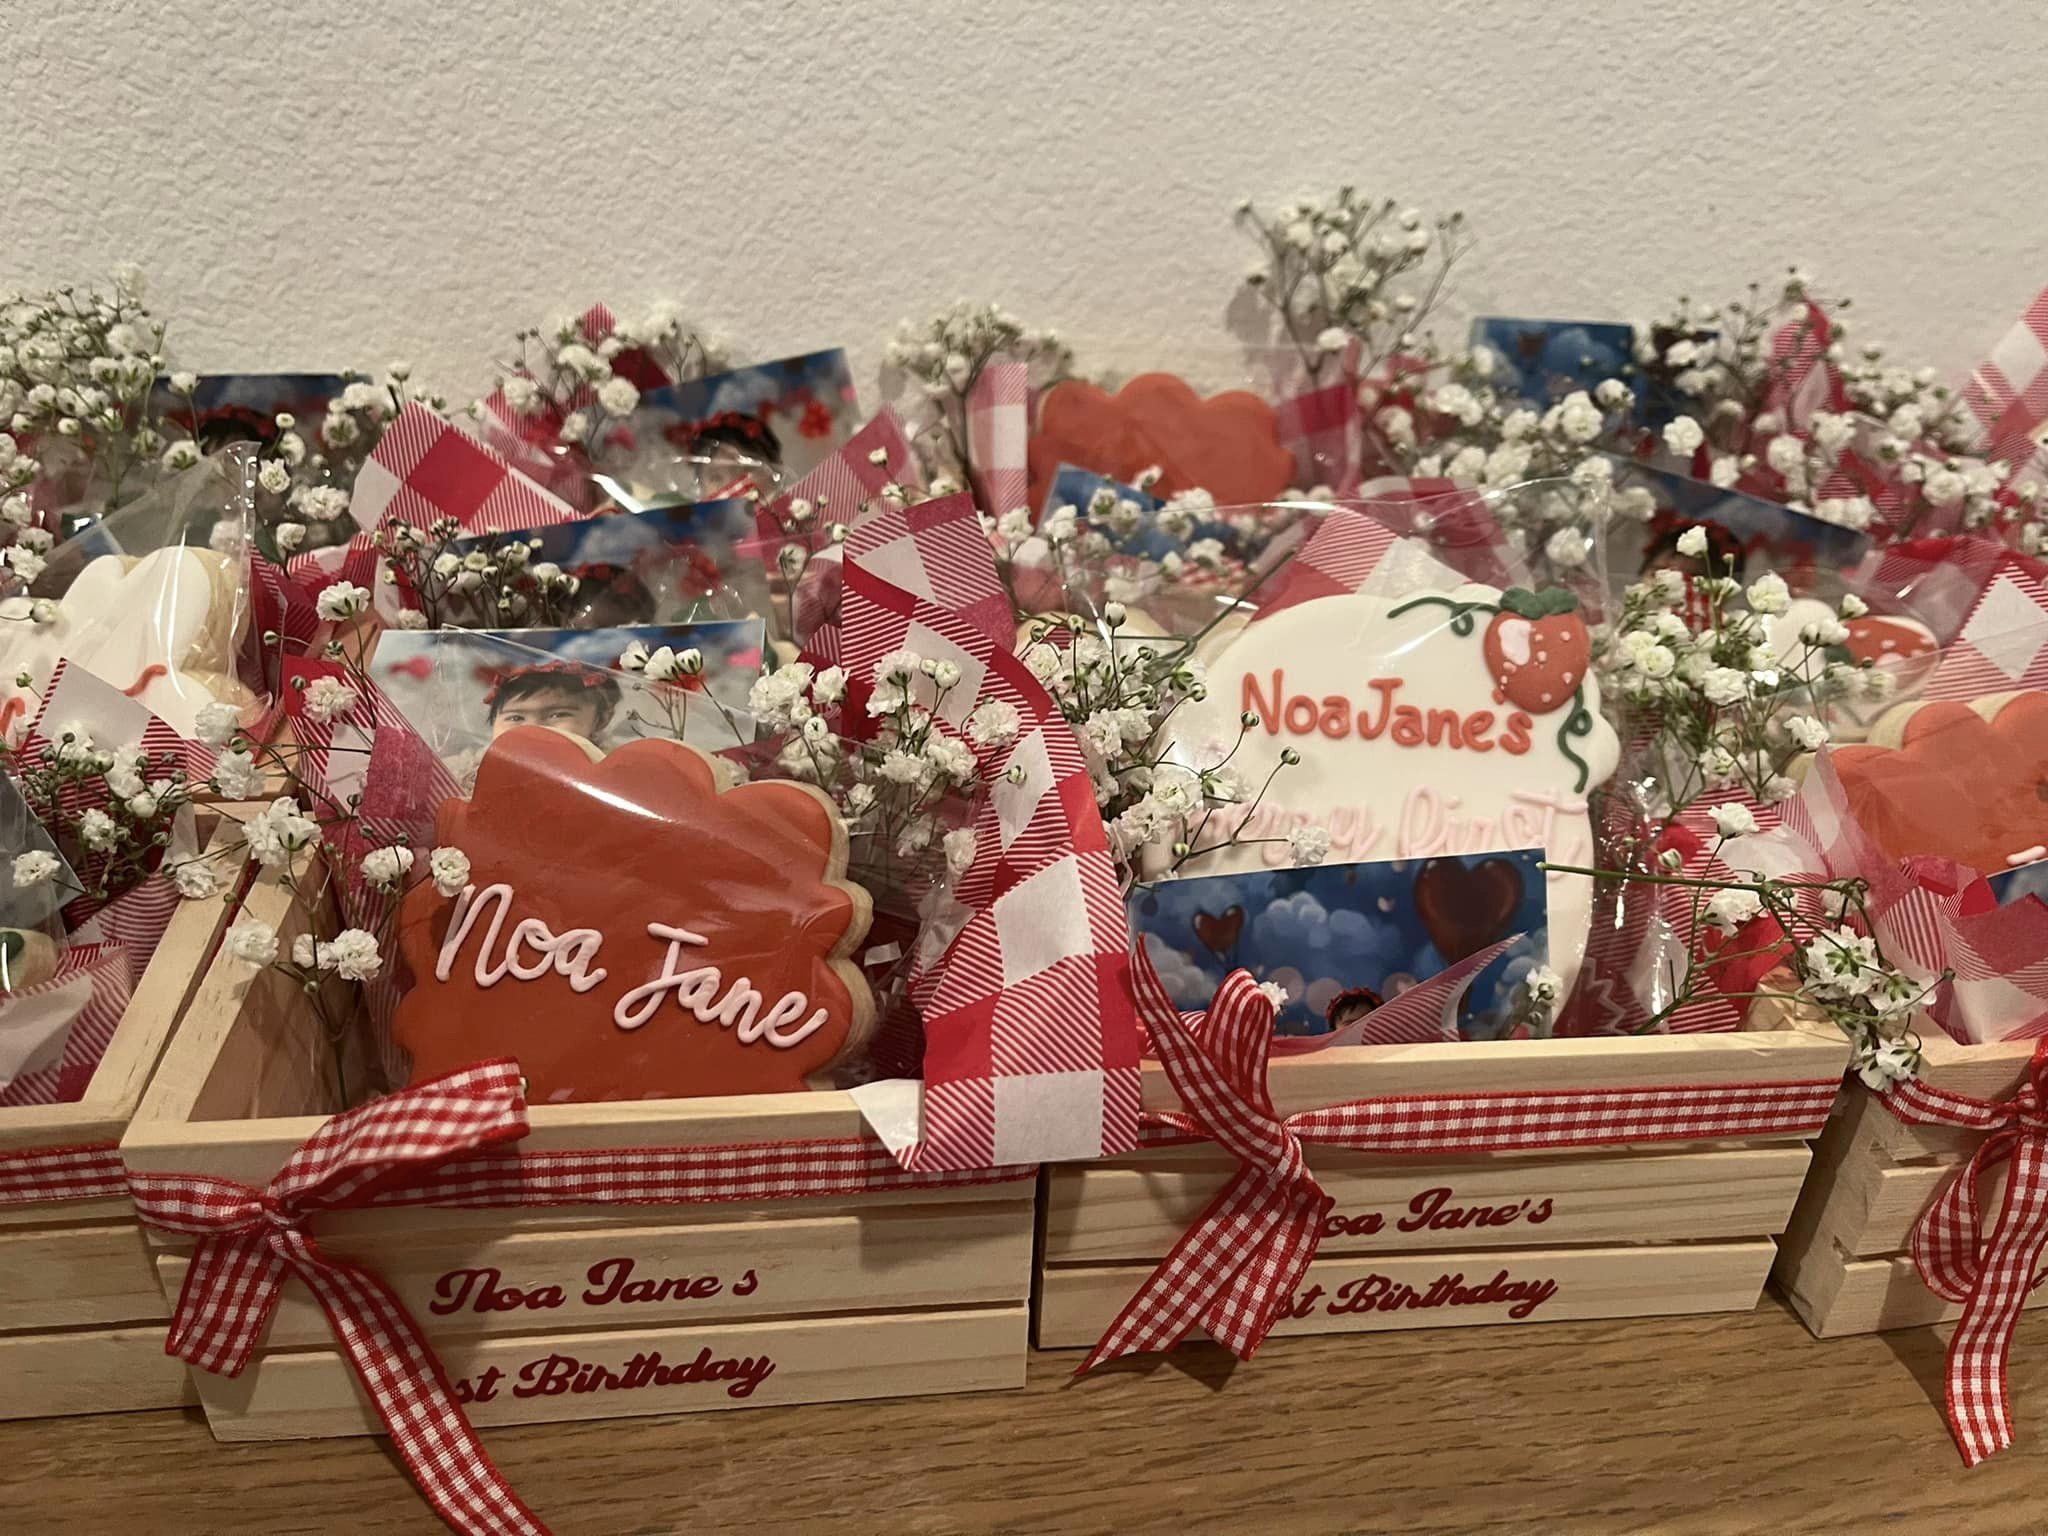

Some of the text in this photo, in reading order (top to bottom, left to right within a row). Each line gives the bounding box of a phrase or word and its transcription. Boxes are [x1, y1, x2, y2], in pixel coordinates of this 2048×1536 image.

[434, 883, 830, 1049] Noa Jane
[1397, 1187, 1554, 1233] Jane's
[429, 1267, 567, 1315] Noa
[1326, 1270, 1559, 1320] Birthday
[455, 1347, 777, 1404] st Birthday
